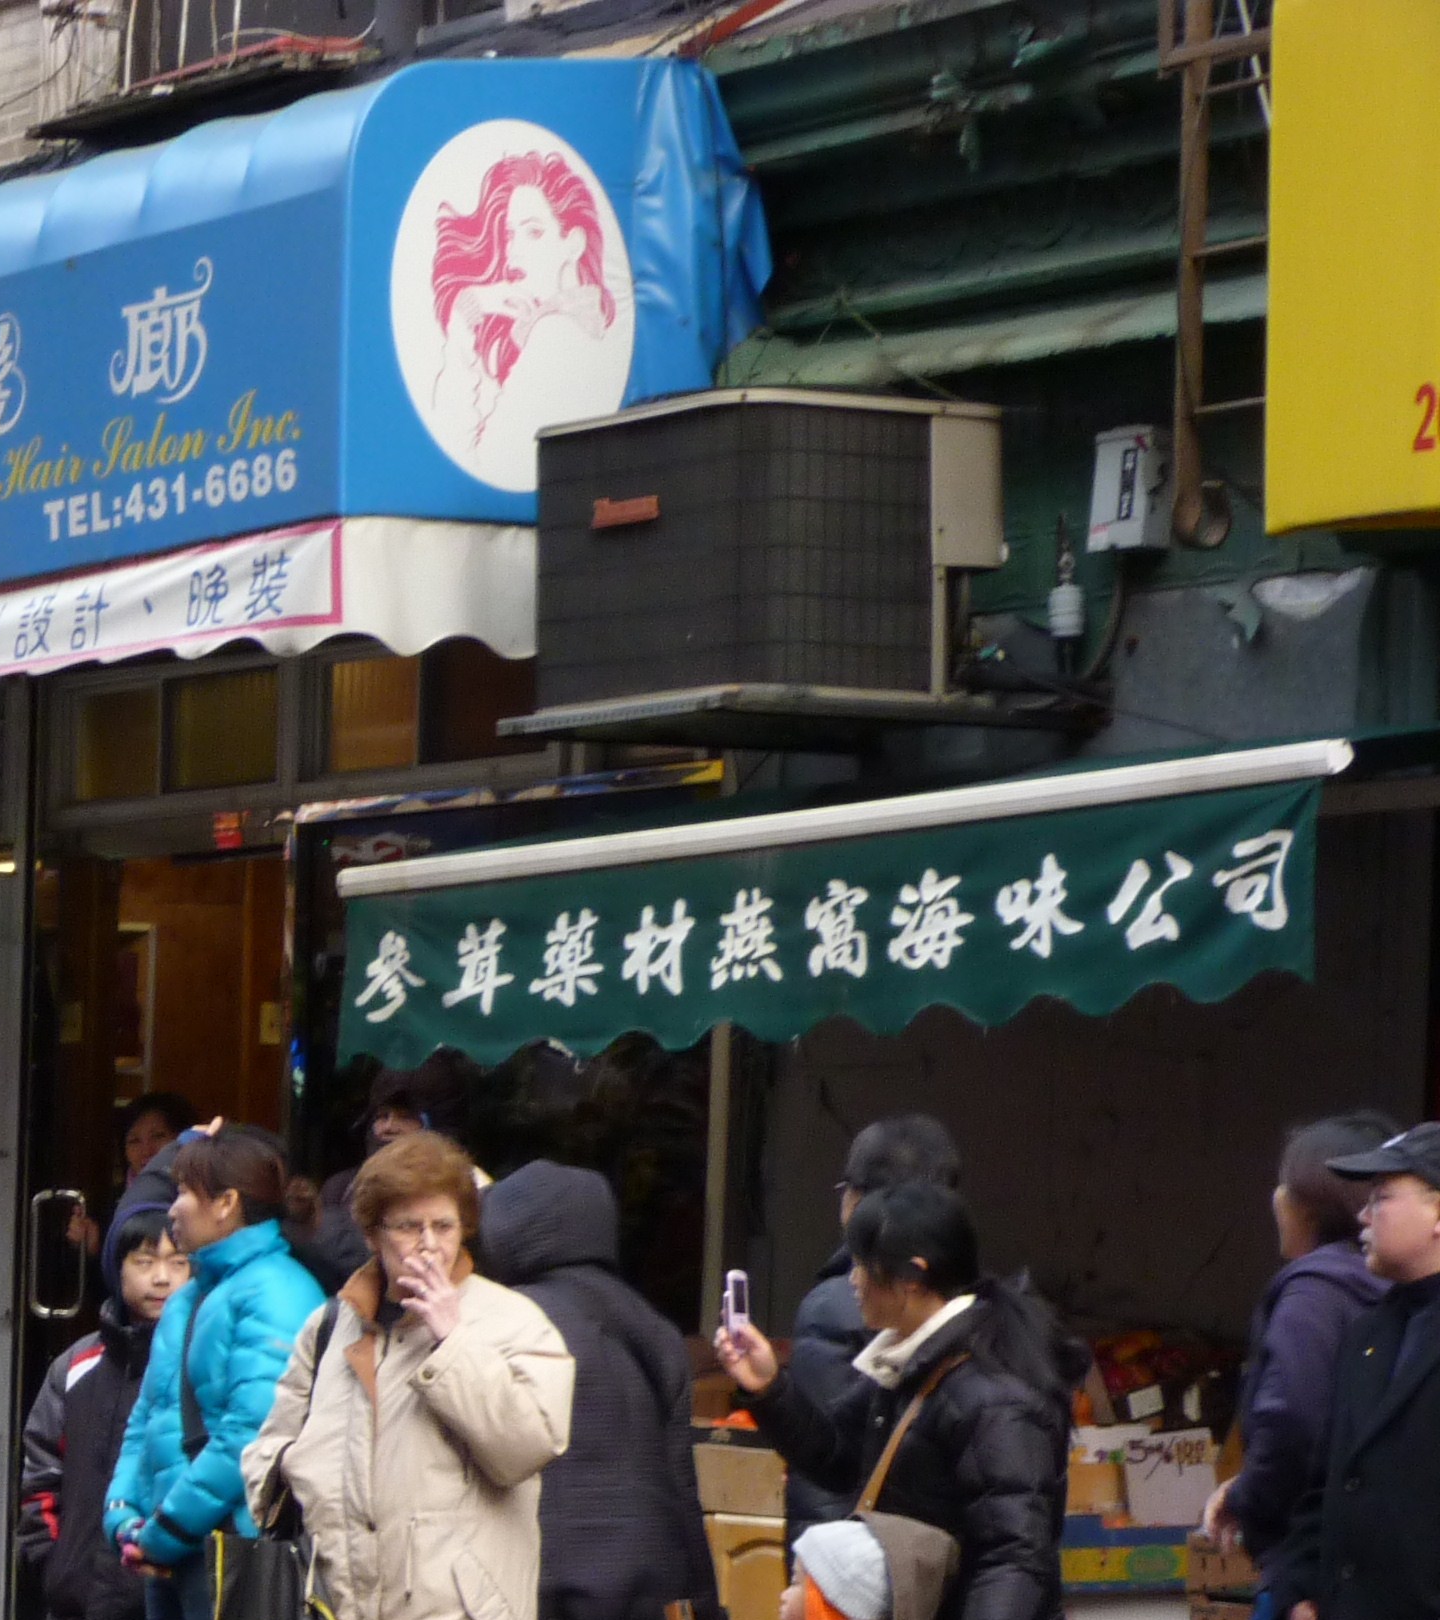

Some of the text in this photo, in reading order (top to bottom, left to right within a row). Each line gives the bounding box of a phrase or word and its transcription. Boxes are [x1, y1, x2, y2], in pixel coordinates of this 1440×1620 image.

[93, 412, 207, 479] Salon
[216, 388, 302, 454] Inc.
[1413, 381, 1440, 453] 2
[42, 447, 299, 543] TEL:431-6686
[354, 828, 1296, 1024] 參茸藥材燕窩海味公司
